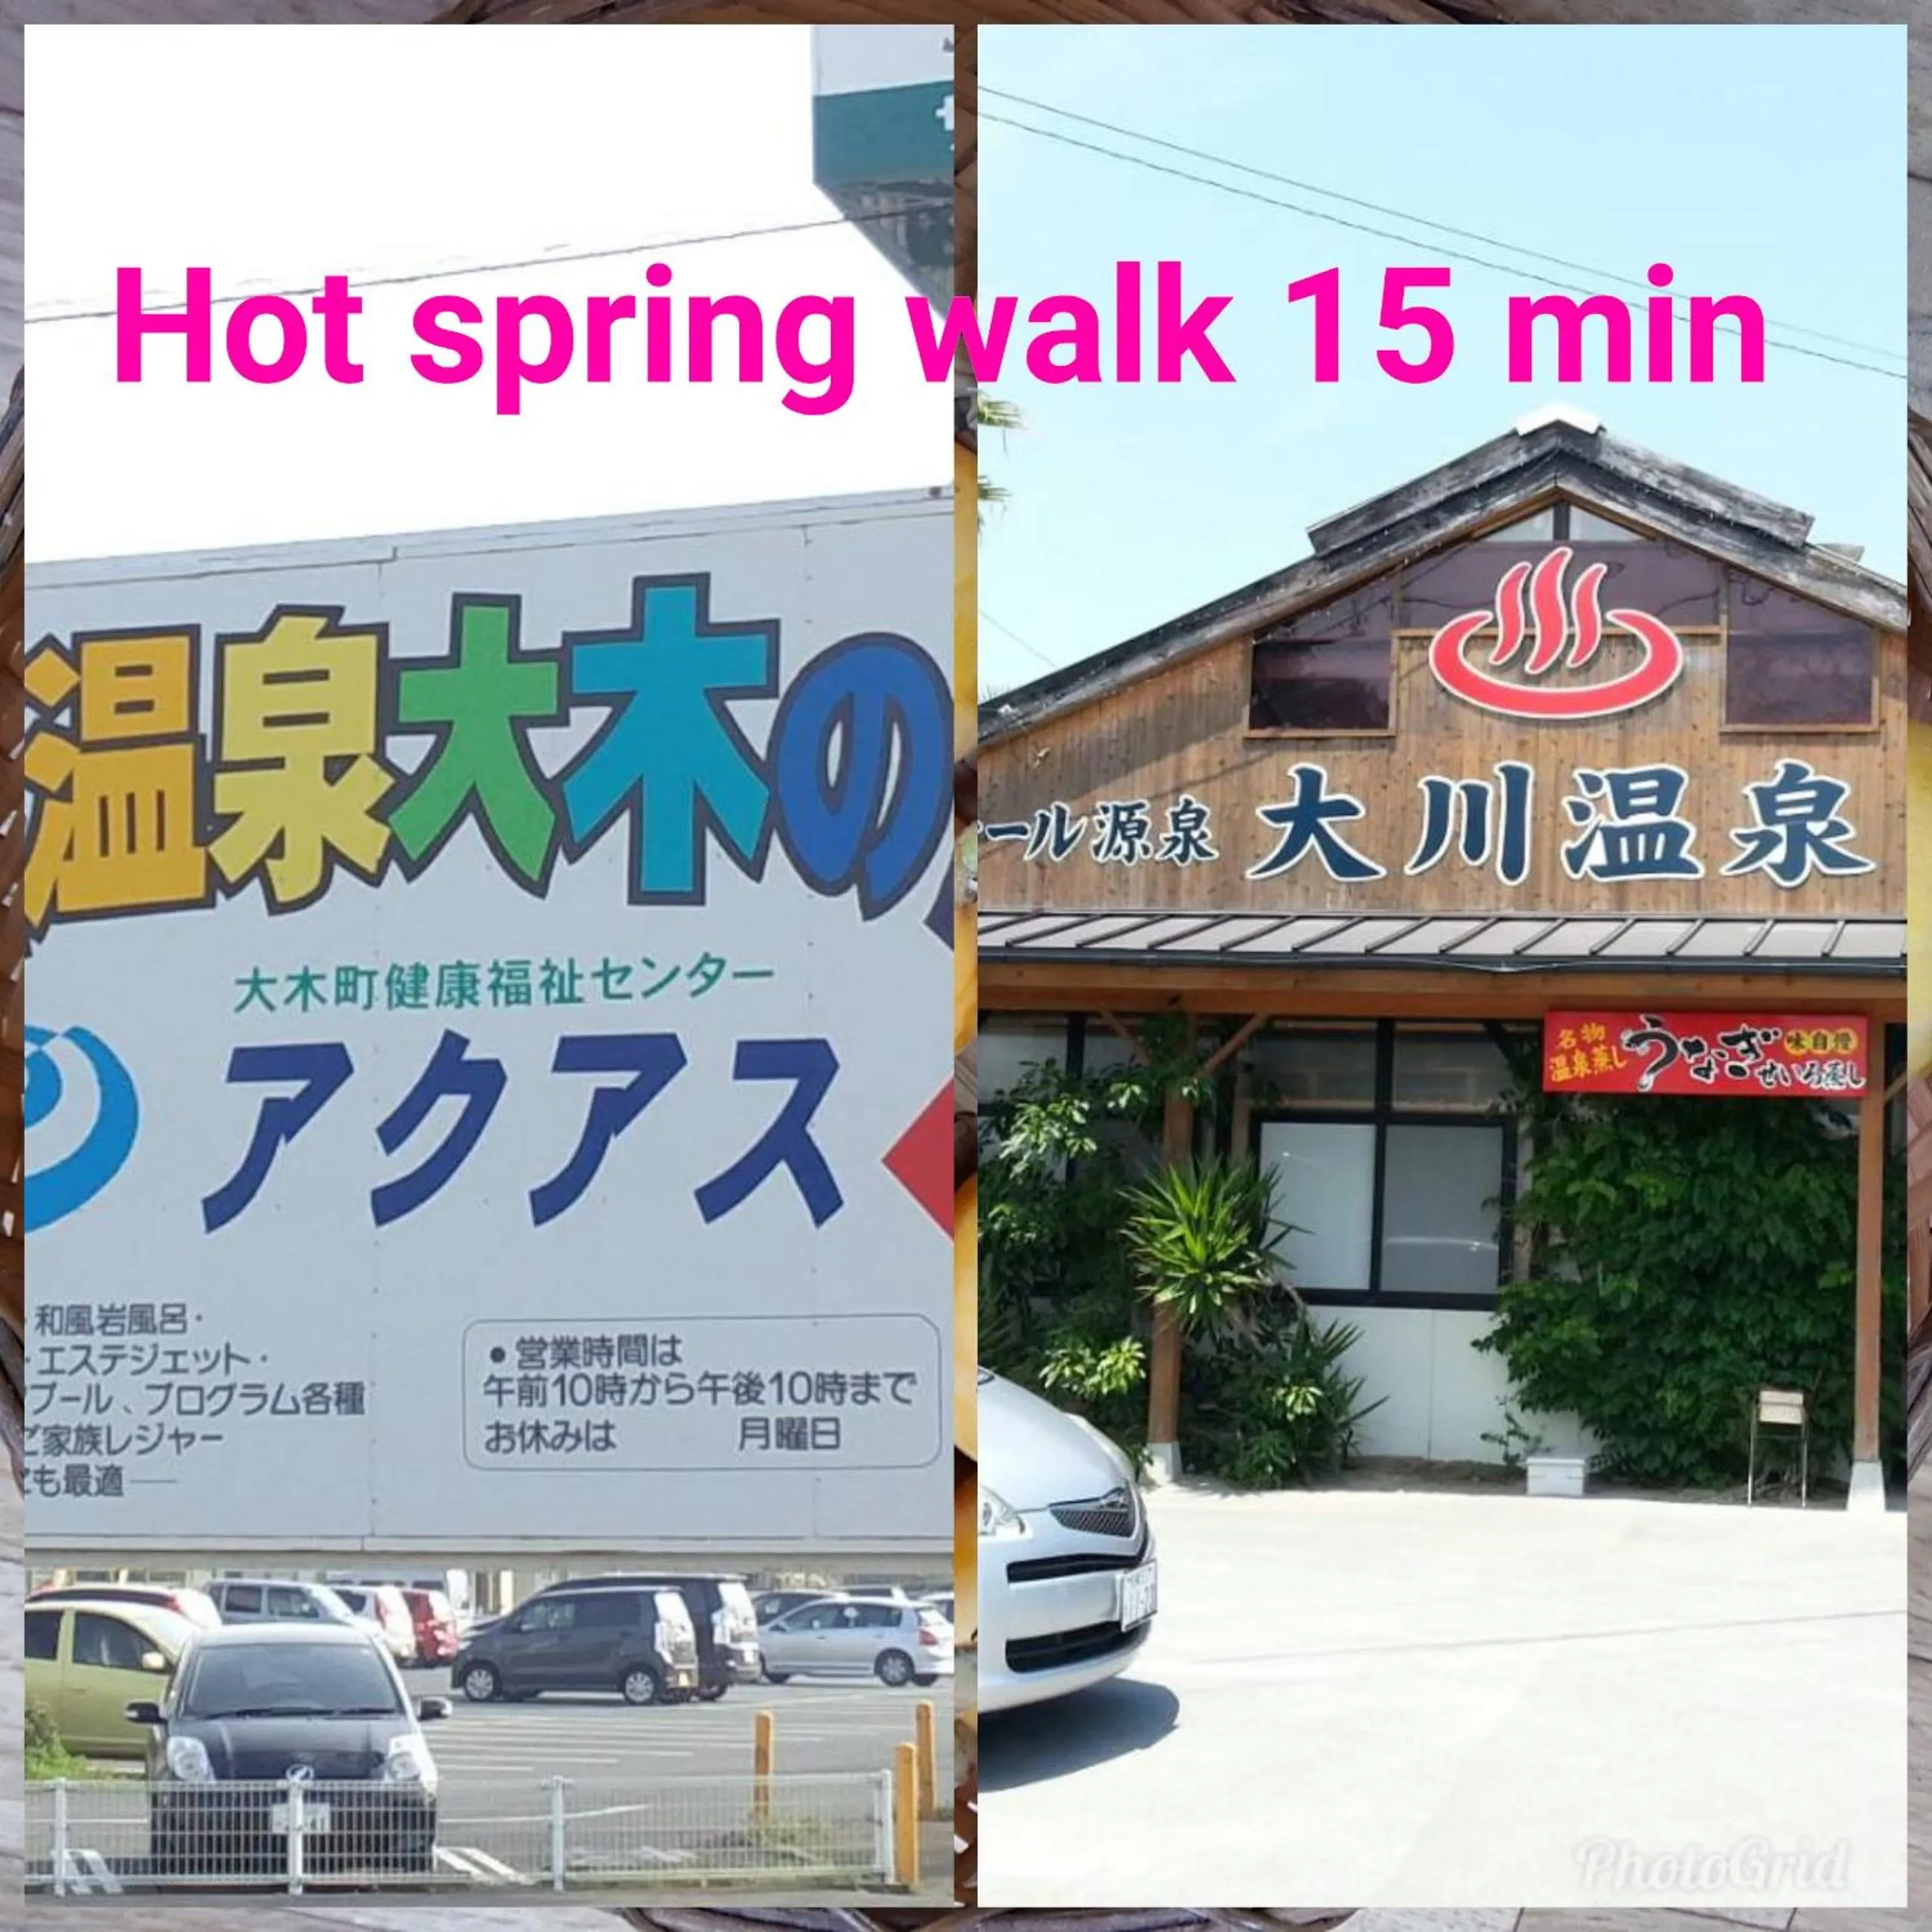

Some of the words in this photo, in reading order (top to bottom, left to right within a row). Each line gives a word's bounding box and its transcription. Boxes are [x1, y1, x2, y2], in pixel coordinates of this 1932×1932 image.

[25, 572, 954, 943] 温泉大木の
[979, 795, 1220, 866] ール源泉
[1244, 759, 1877, 888] 大川温泉
[234, 951, 775, 1013] 大木町健康福祉センター
[201, 1027, 844, 1235] アクアス
[515, 1333, 683, 1371] 営業時間は
[25, 1380, 367, 1417] プール、プログラム各種
[482, 1370, 918, 1408] 午前10時から午後10時まで
[484, 1418, 617, 1454] お休みは
[737, 1416, 841, 1452] 月曜日
[25, 1463, 125, 1499] も最適
